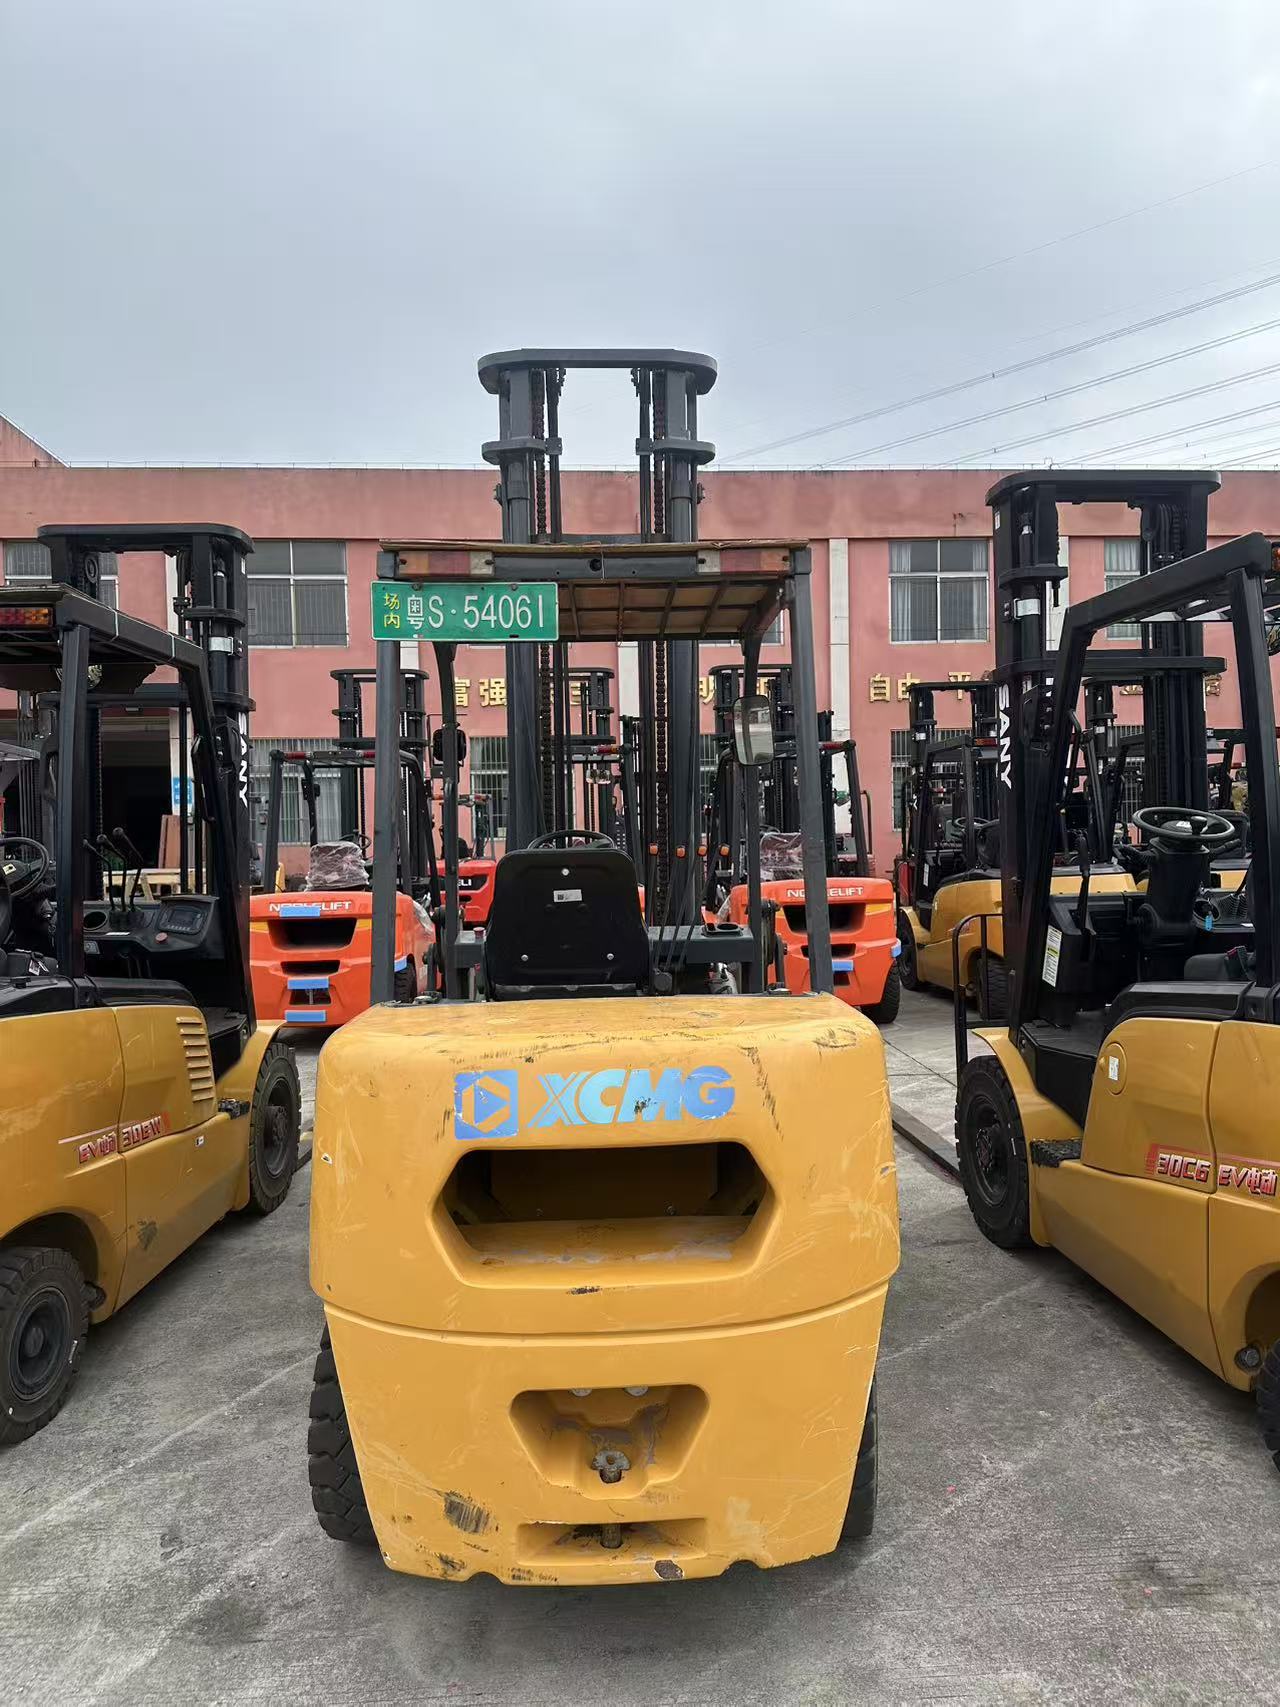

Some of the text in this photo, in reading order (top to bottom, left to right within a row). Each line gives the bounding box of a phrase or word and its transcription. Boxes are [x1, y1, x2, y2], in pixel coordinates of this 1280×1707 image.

[383, 592, 400, 629] 场内
[998, 683, 1012, 790] SANY
[526, 1065, 736, 1129] XCMG
